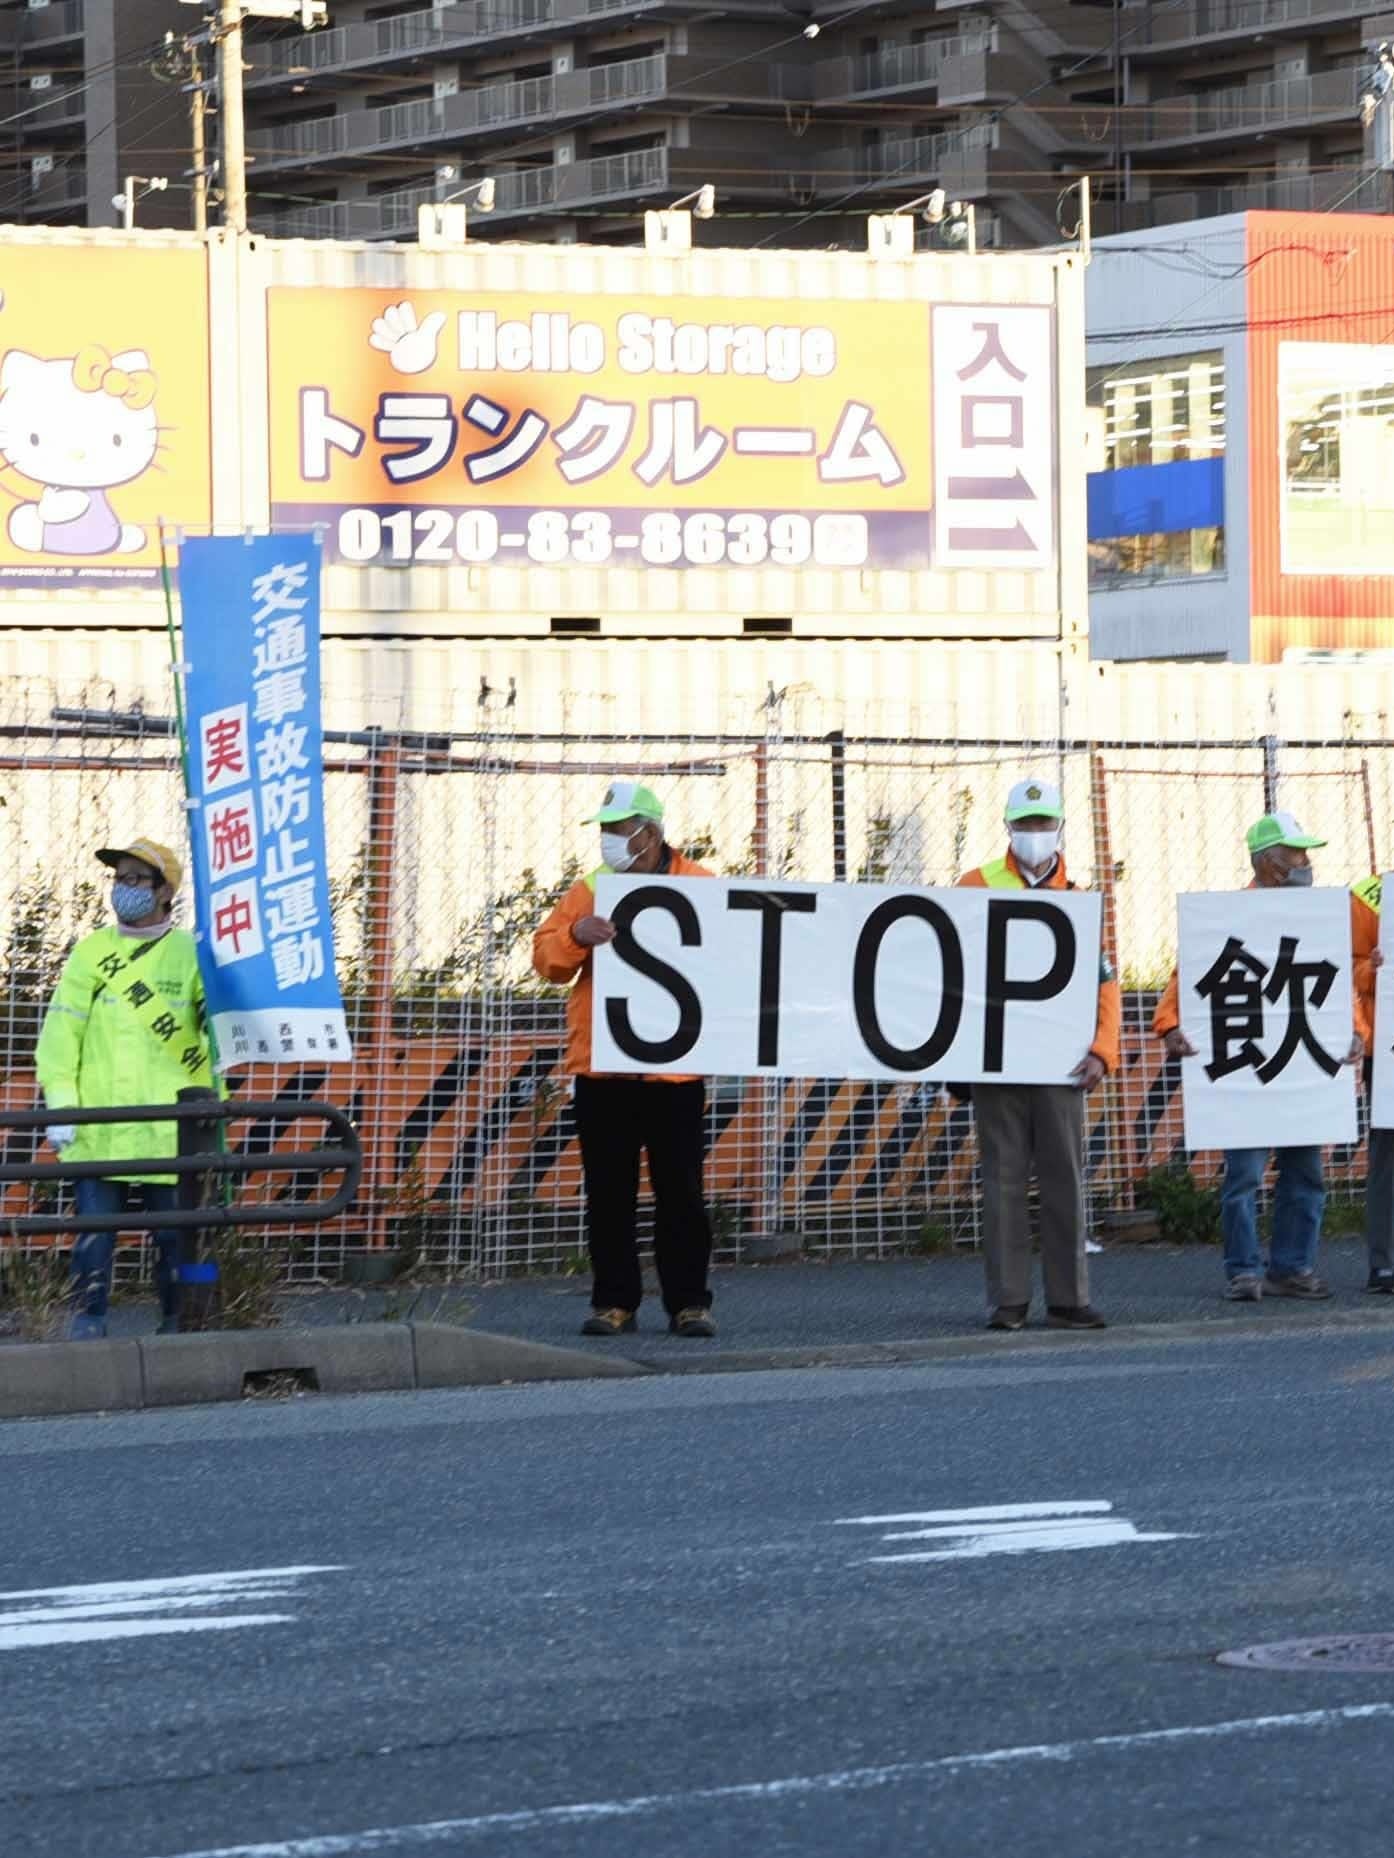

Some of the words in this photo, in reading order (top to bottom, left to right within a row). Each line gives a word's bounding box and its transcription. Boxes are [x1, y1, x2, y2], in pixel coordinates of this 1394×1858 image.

[457, 311, 605, 374] Hello
[617, 312, 837, 383] Storage
[956, 322, 1029, 450] 入口
[299, 386, 907, 488] トランクルーム
[338, 509, 812, 566] 0120-83-8639
[205, 718, 254, 954] 実施中
[251, 561, 326, 991] 交通事故防止運動
[604, 885, 1077, 1073] STOP
[1194, 935, 1344, 1085] 飲
